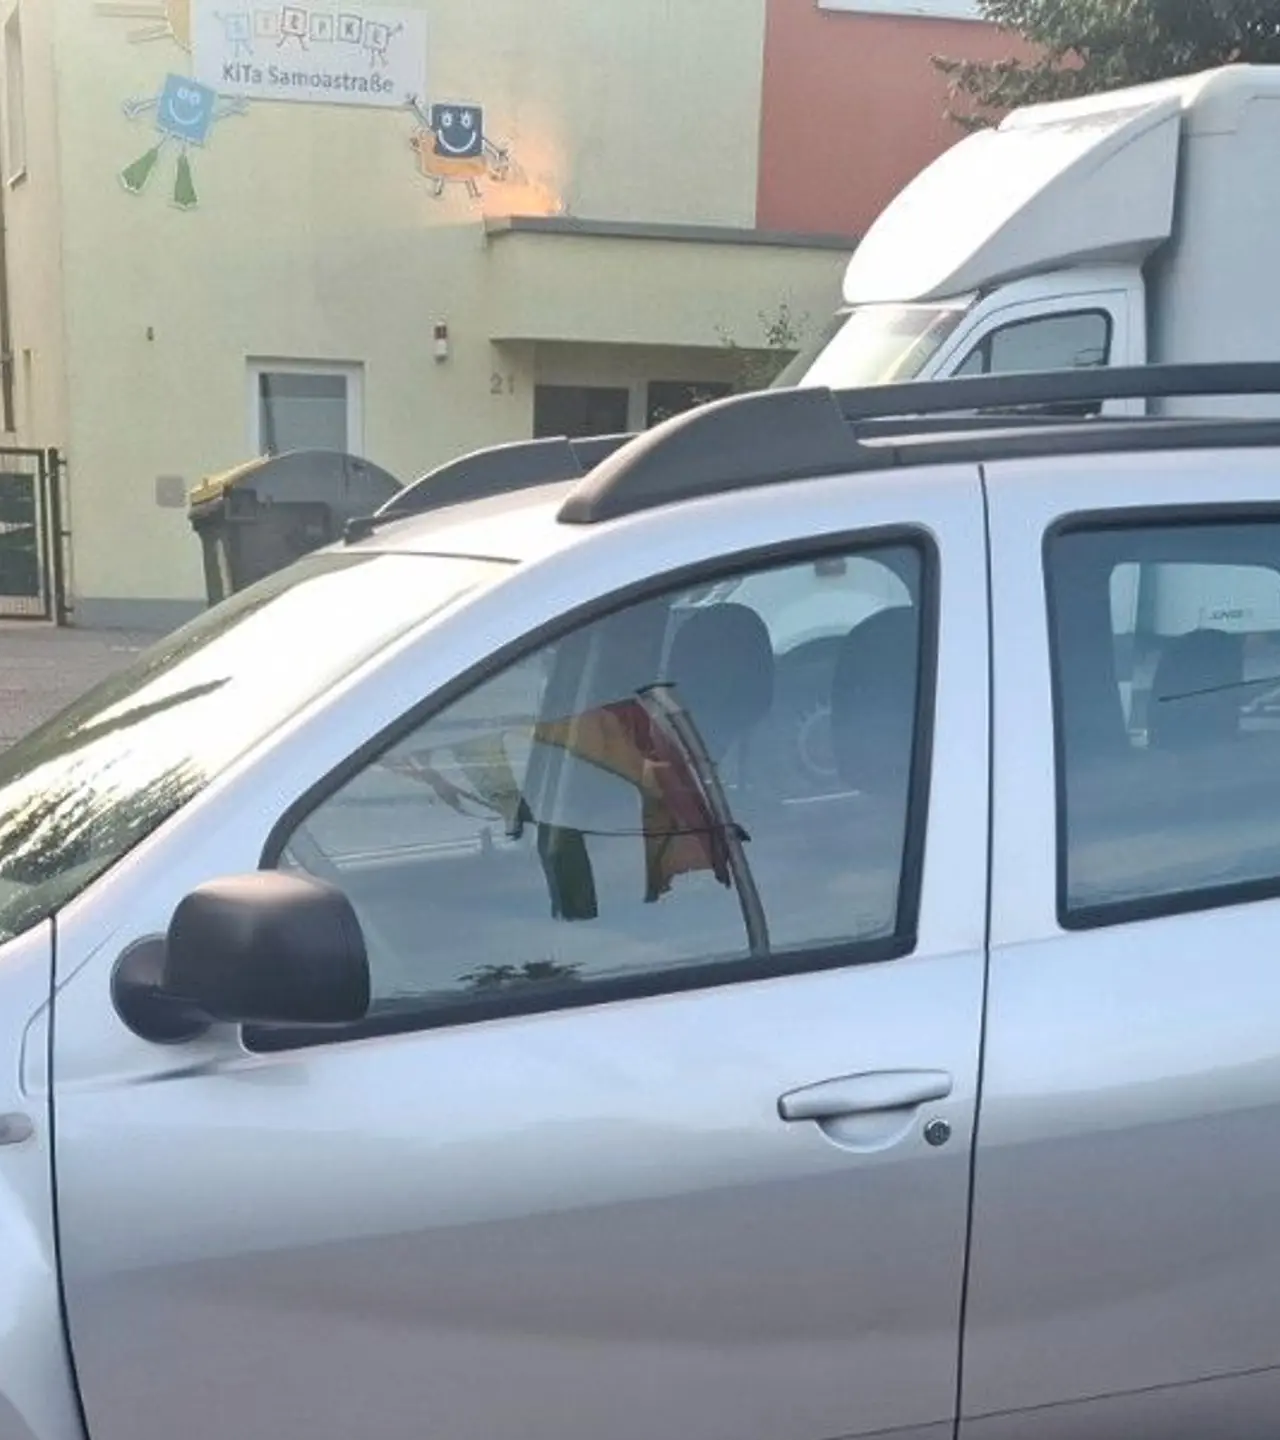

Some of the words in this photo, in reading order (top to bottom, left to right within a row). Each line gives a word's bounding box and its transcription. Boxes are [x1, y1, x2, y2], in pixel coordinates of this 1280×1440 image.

[223, 63, 262, 84] KiTa
[268, 65, 395, 93] Samoastraße
[489, 372, 515, 395] 21
